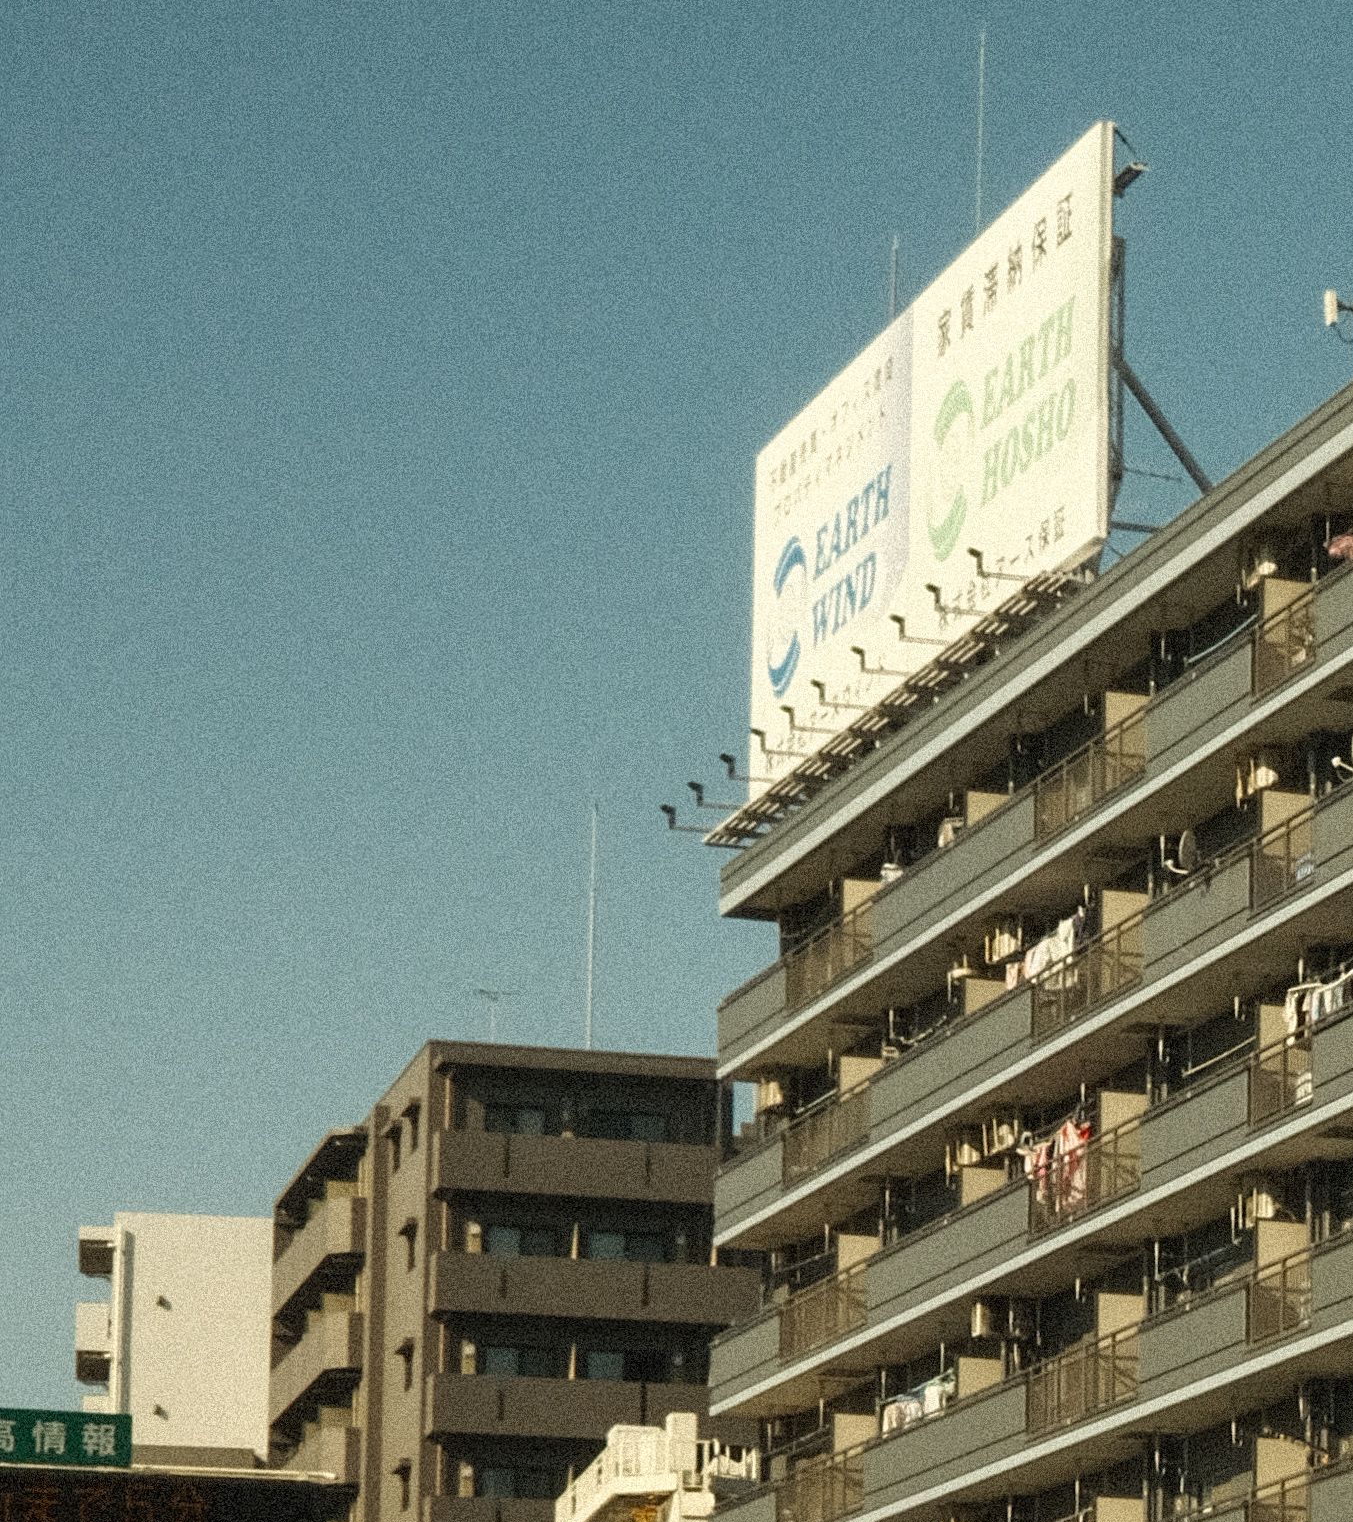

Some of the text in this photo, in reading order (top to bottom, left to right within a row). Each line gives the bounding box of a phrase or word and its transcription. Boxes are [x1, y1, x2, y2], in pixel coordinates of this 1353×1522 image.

[980, 294, 1076, 431] EARTH
[980, 378, 1077, 509] HOSHO
[811, 462, 894, 584] EARTH
[811, 551, 878, 650] WIND
